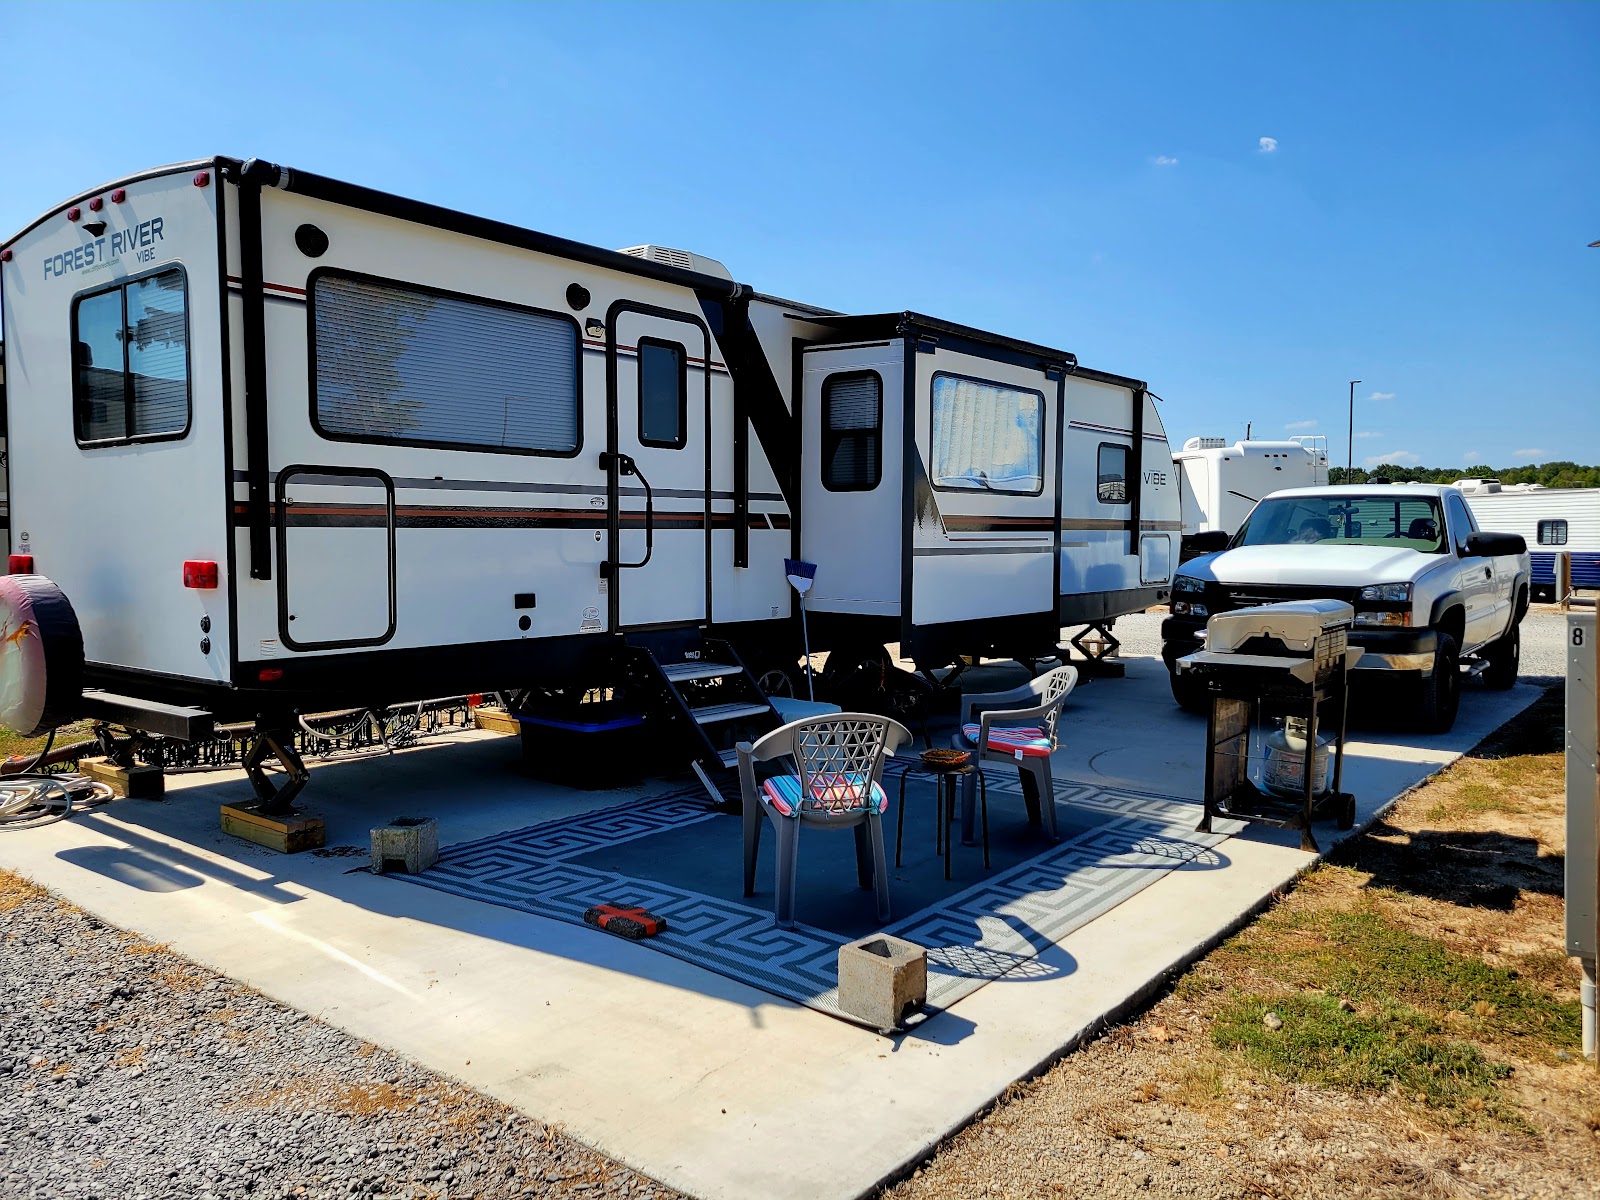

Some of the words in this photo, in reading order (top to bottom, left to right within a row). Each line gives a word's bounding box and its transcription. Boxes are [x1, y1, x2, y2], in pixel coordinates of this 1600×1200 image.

[43, 238, 106, 281] FOREST
[111, 217, 164, 257] RIVER
[136, 247, 156, 263] VIBE
[1143, 473, 1166, 485] VIBE
[1572, 627, 1583, 645] 8
